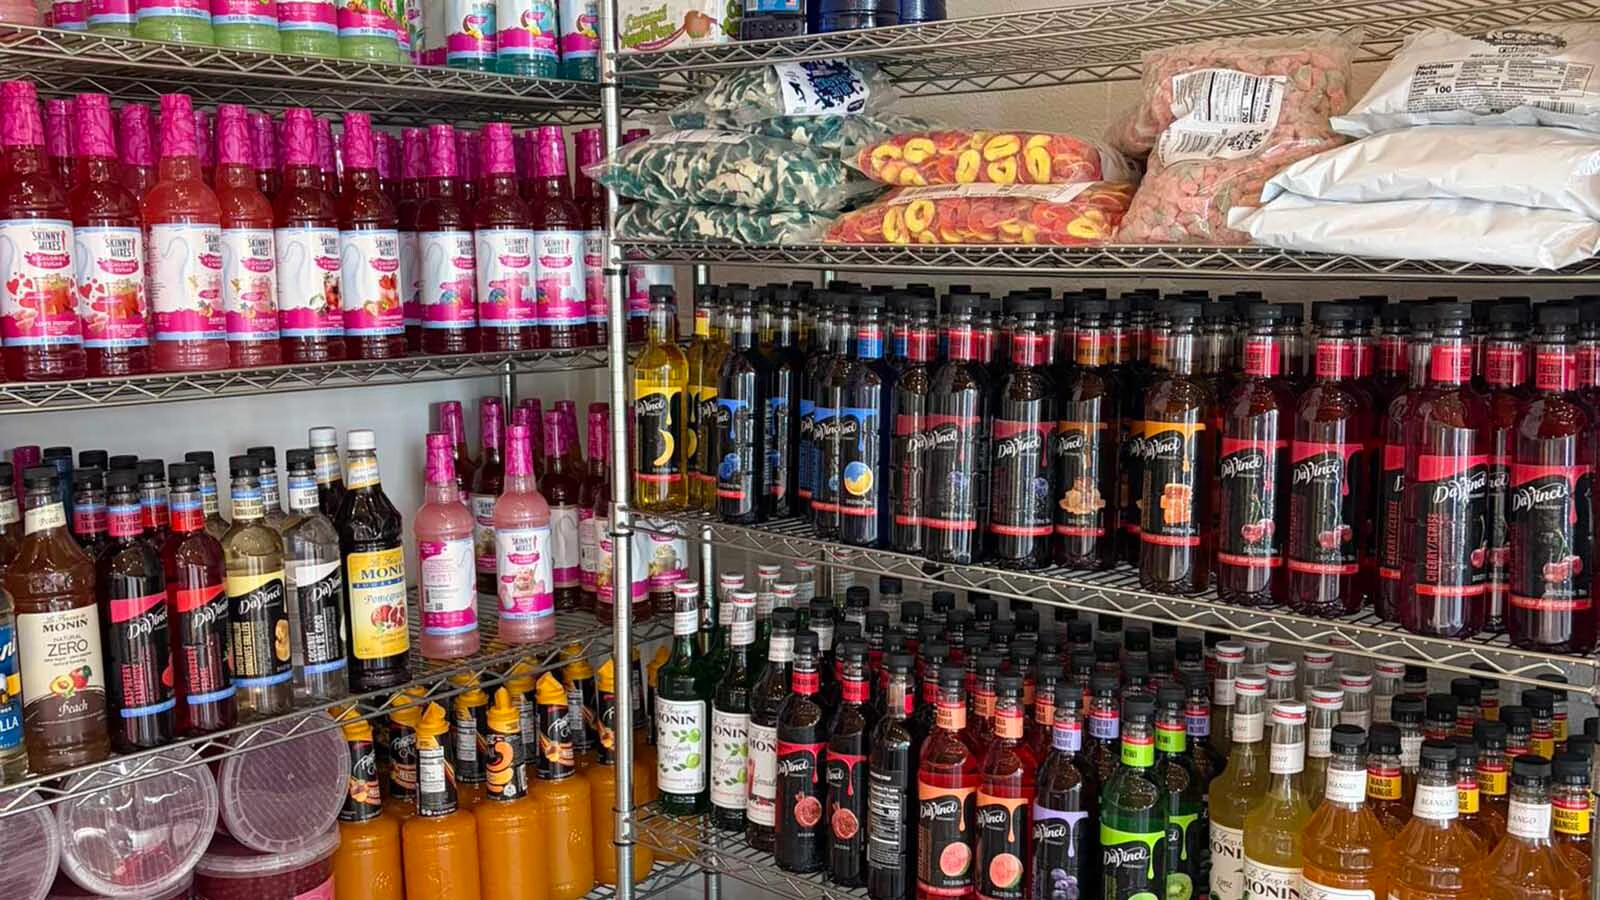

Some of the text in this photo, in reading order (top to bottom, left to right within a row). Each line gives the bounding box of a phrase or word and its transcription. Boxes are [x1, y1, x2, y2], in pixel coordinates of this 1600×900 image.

[1435, 86, 1452, 94] 100
[1242, 106, 1250, 123] 120
[998, 433, 1042, 458] DaVinci
[1221, 454, 1264, 478] DaVinci
[1293, 460, 1339, 485] DaVinci
[1432, 471, 1486, 504] DaVinci
[1512, 482, 1568, 512] DaVinci
[238, 587, 281, 614] DaVinci
[42, 618, 88, 633] MONIN
[47, 638, 88, 657] ZERO
[58, 700, 89, 717] Peach
[920, 799, 957, 821] DaVinci
[1104, 846, 1150, 868] DaVinci
